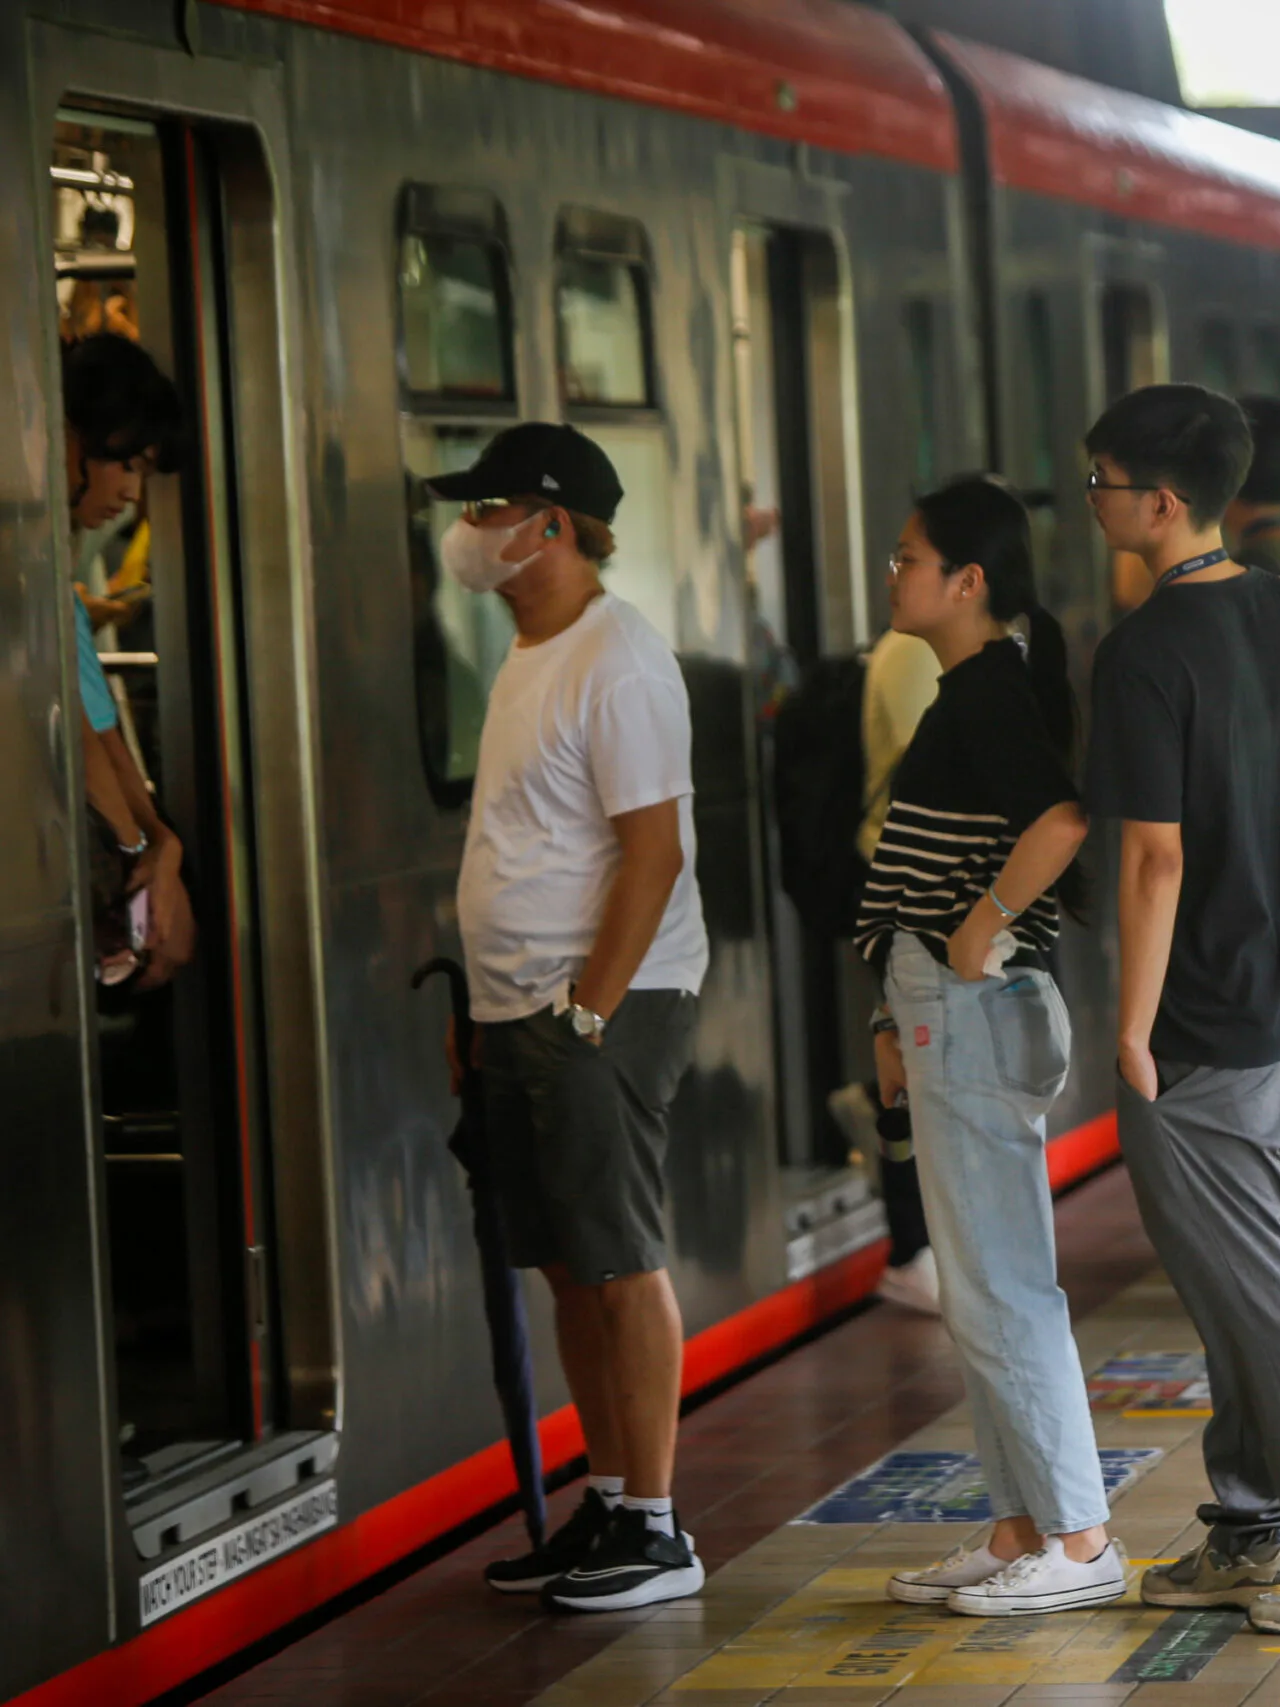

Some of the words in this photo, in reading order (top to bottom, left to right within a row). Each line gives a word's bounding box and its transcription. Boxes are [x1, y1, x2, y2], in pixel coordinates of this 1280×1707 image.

[143, 1571, 173, 1617] WATCH
[174, 1558, 196, 1600] YOUR
[197, 1547, 218, 1587] STEP
[825, 1652, 909, 1676] GIVE
